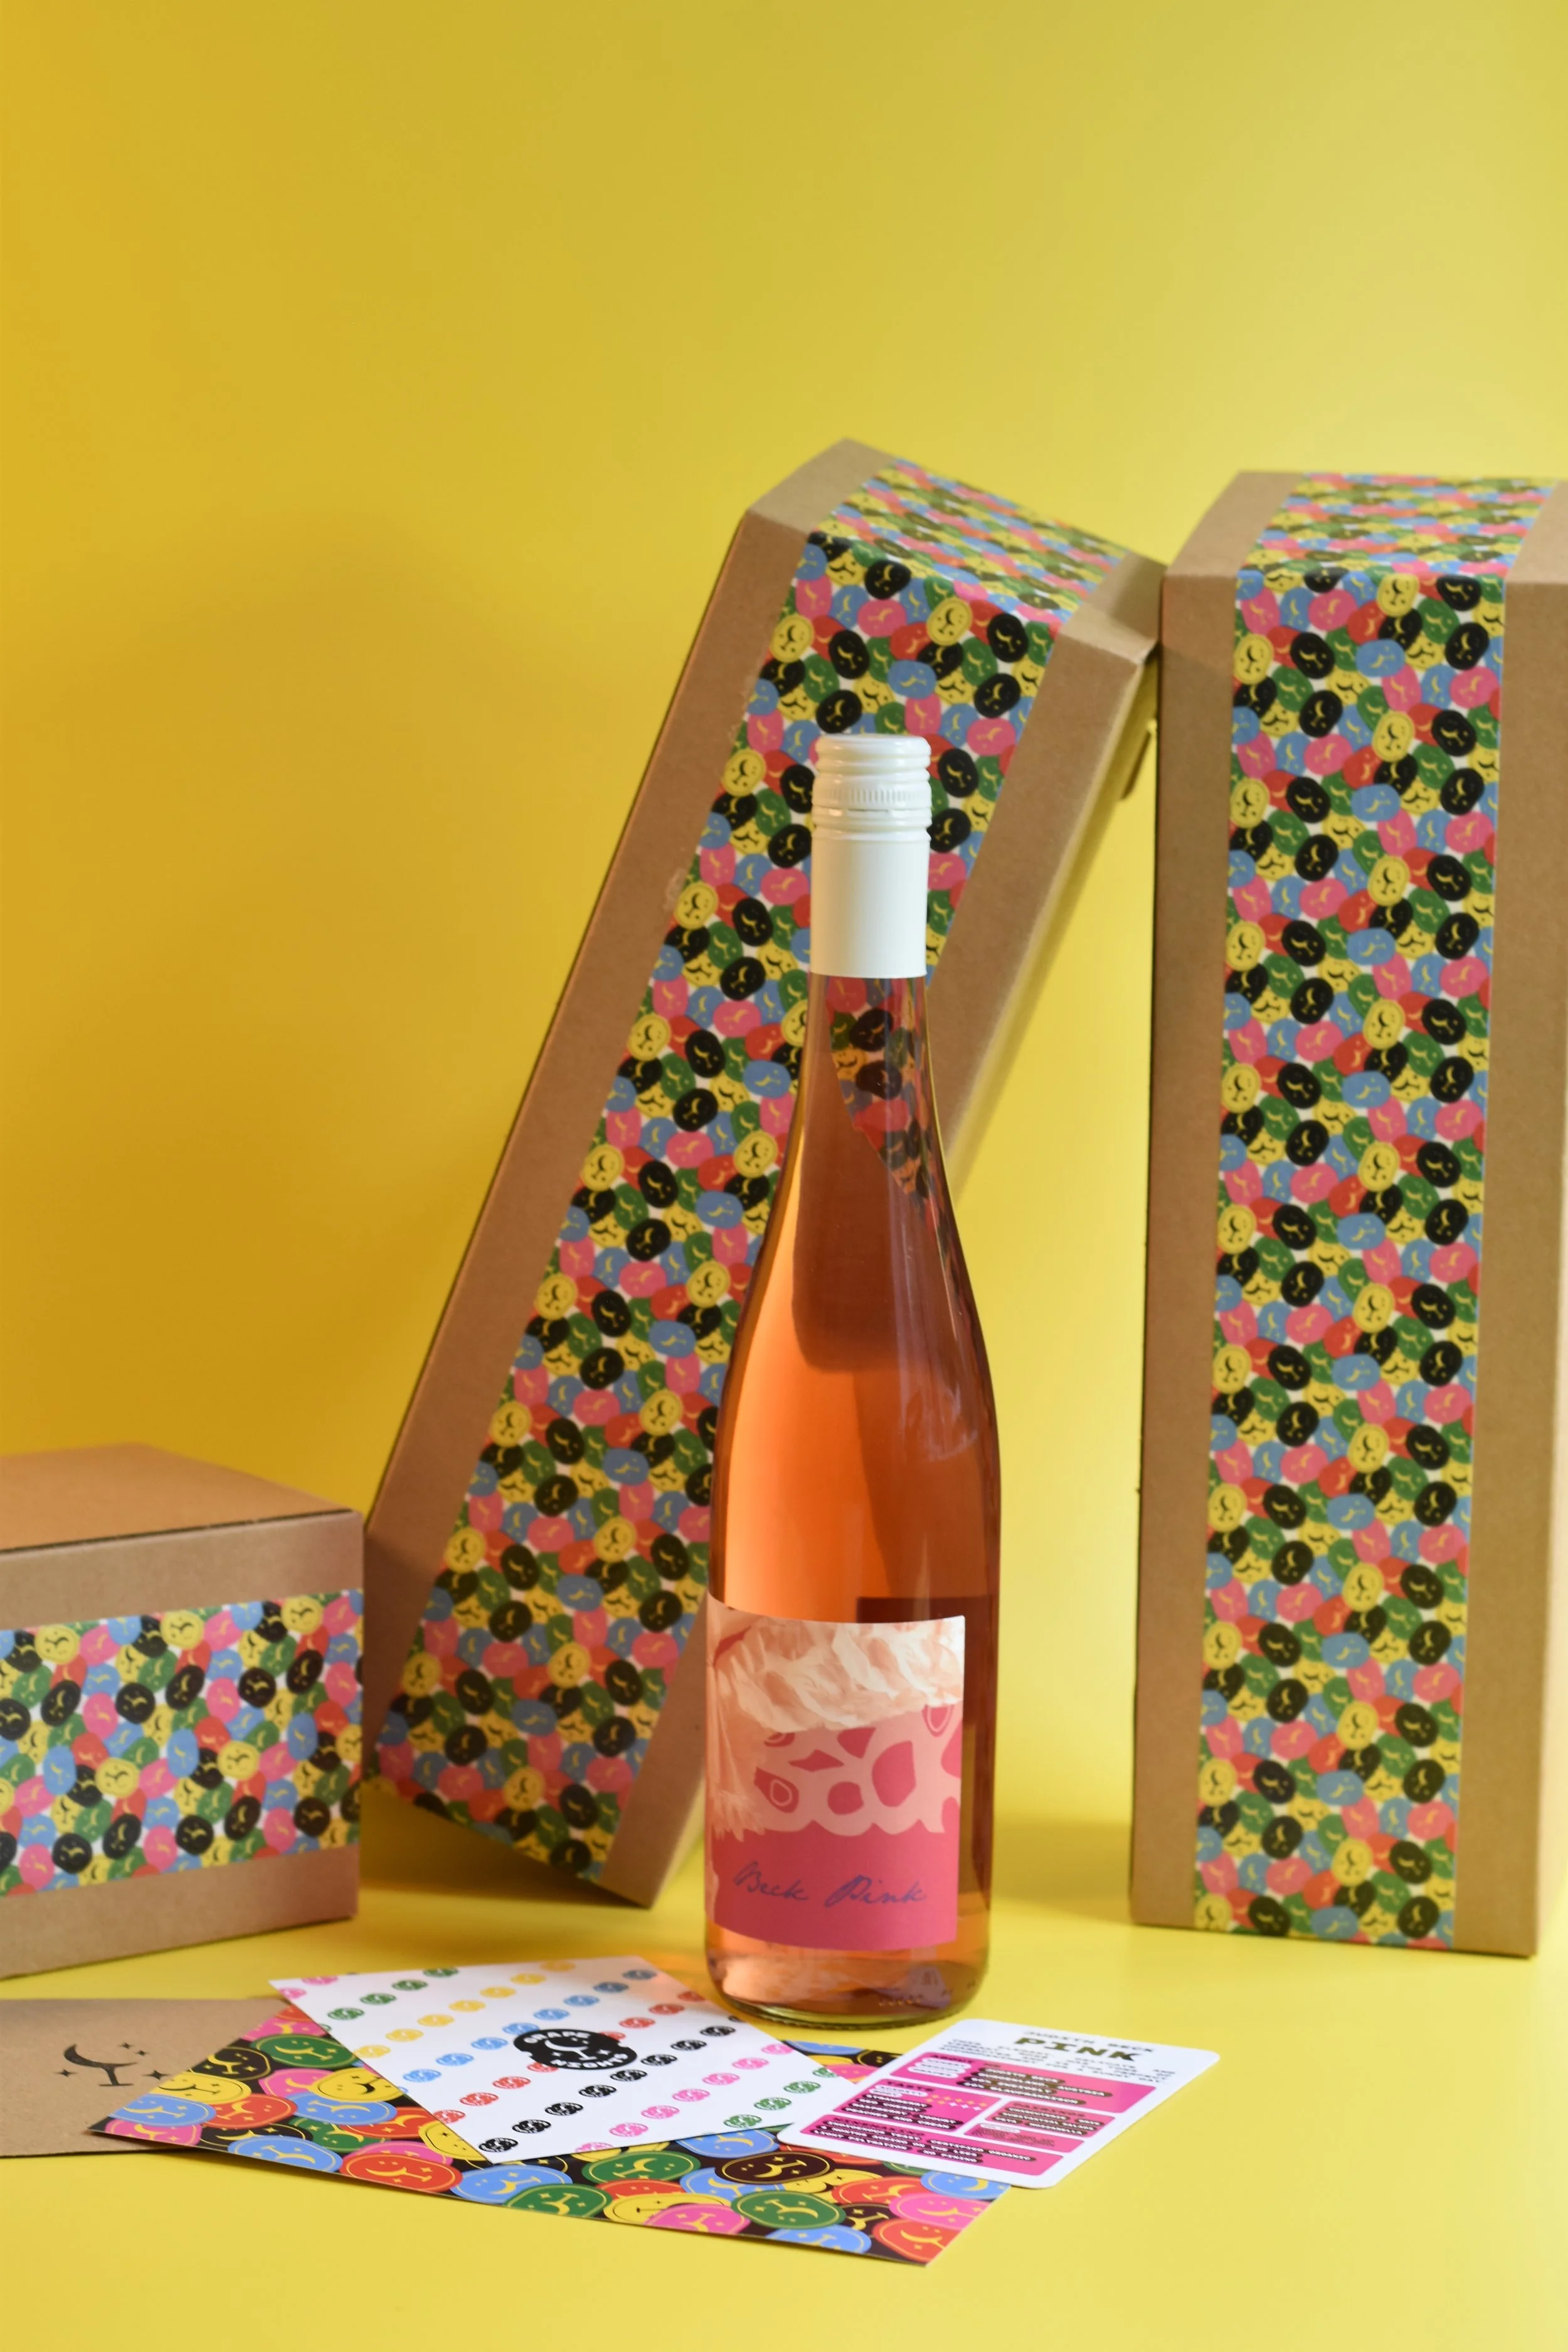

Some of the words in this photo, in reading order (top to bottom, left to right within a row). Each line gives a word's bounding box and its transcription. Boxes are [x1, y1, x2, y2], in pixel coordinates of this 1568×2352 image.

[733, 1862, 808, 1902] Beck
[824, 1874, 926, 1908] Pink
[524, 2031, 591, 2044] GRAPE
[1014, 2037, 1141, 2060] PINK
